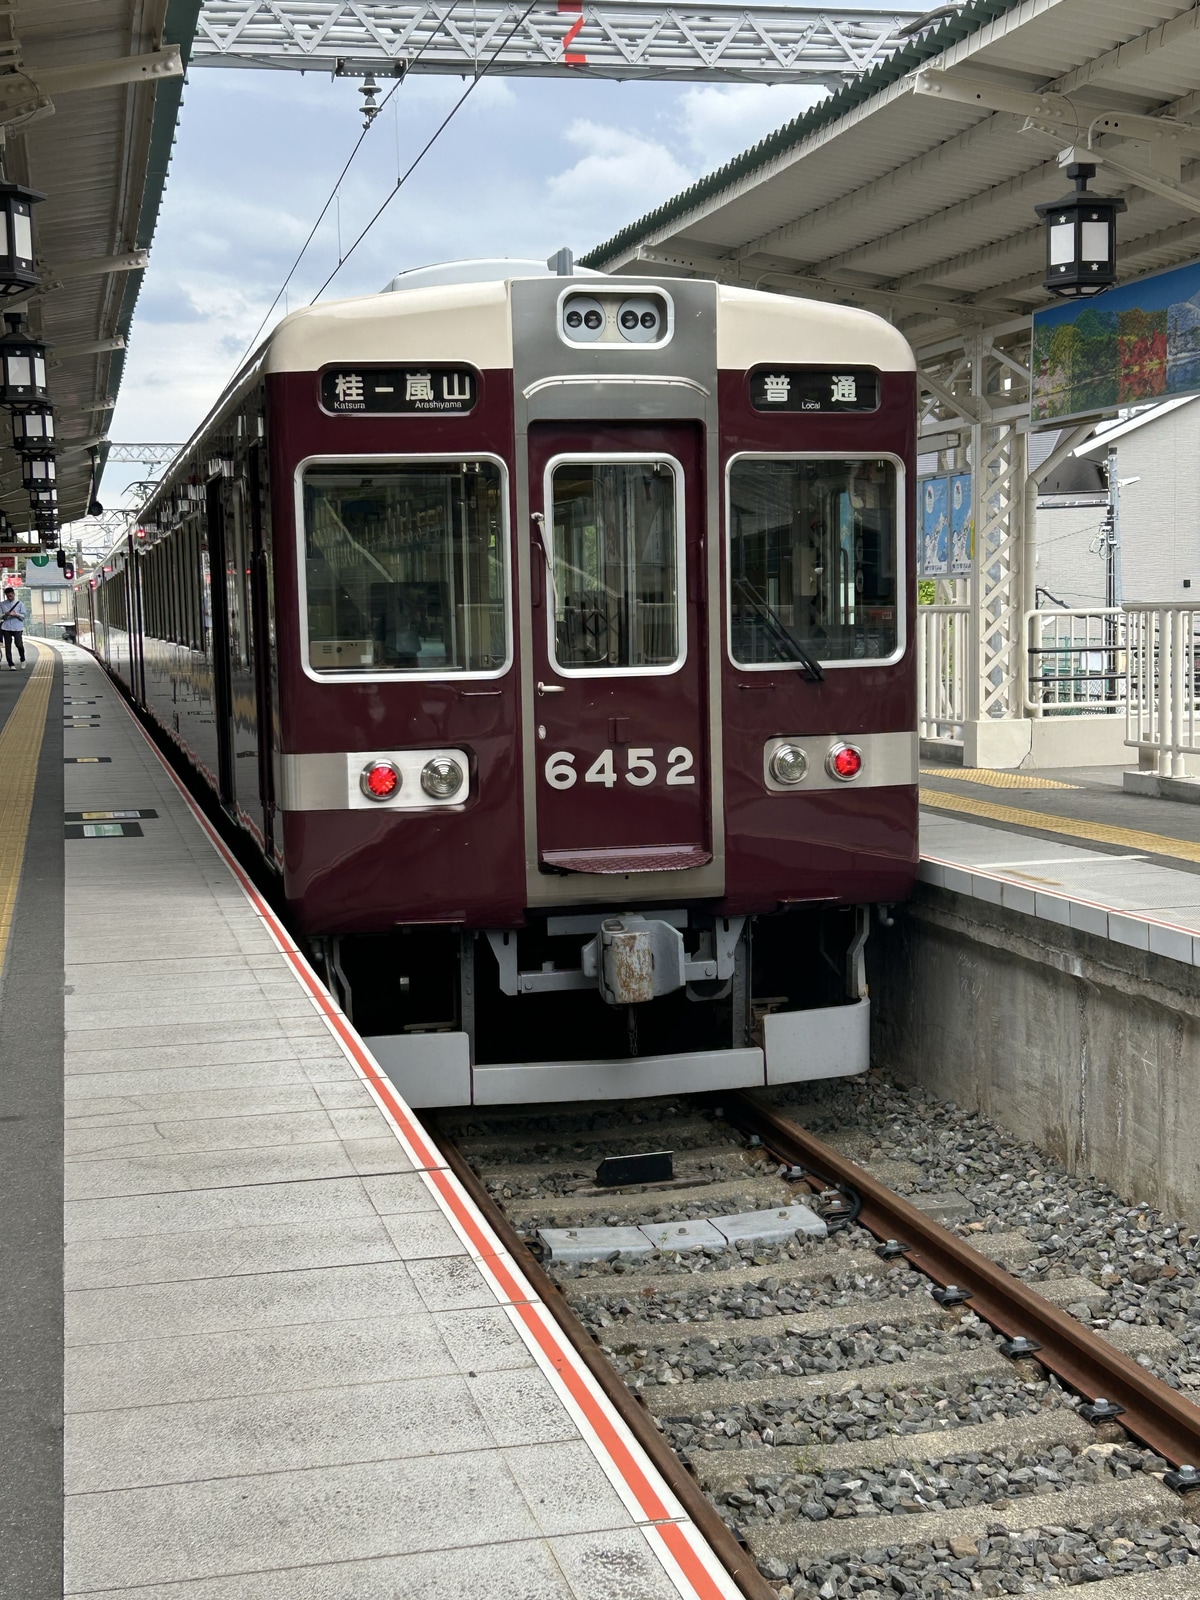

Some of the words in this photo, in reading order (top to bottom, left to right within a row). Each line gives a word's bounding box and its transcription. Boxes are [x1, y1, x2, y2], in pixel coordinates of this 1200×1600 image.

[763, 374, 858, 402] 普通
[334, 401, 366, 409] Katsura
[415, 401, 462, 410] Arashiyama
[801, 402, 821, 410] Local
[544, 746, 696, 790] 6452
